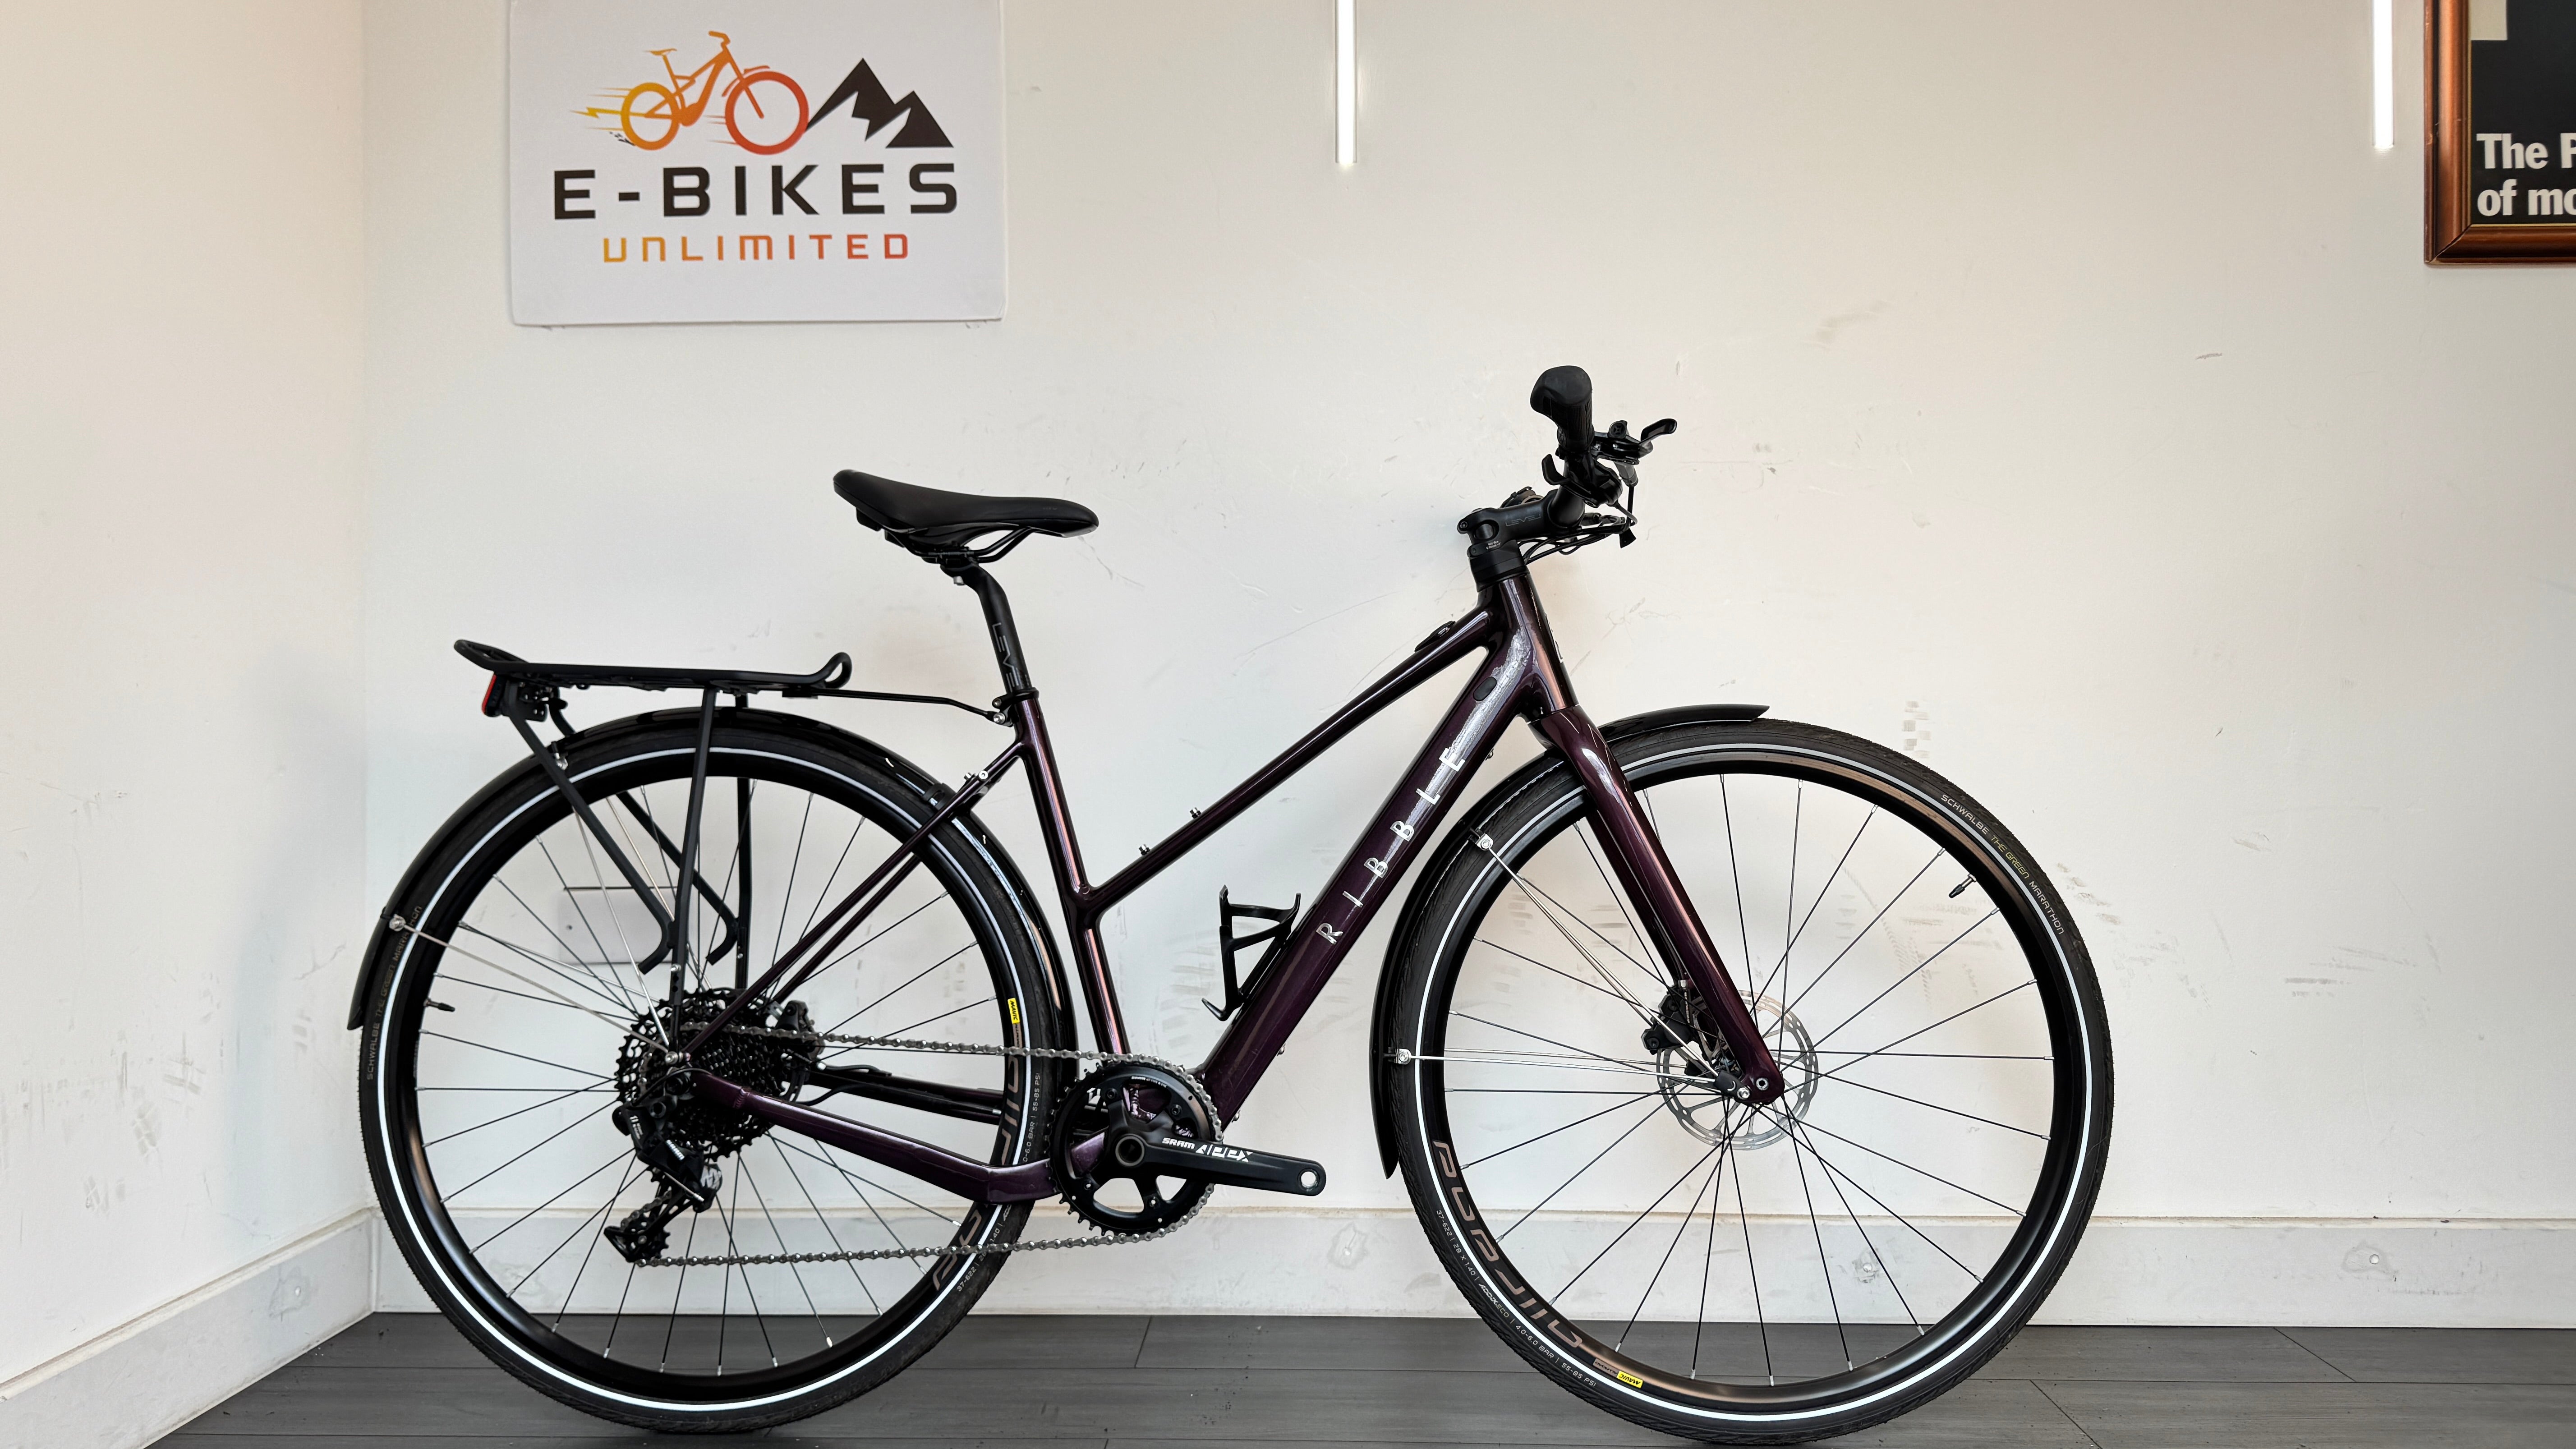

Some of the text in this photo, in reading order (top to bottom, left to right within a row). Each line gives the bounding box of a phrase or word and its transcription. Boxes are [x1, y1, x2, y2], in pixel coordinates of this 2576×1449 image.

[2476, 133, 2549, 170] The
[553, 162, 957, 220] E-BIKES
[2477, 179, 2517, 216] of
[603, 233, 908, 263] UNLIMITED
[992, 622, 1019, 693] LEVE
[1316, 748, 1466, 945] RIBBLE
[1941, 794, 2065, 935] SCHWALBE THE GREEN MARATHON
[392, 906, 422, 964] MARAHON
[1009, 1000, 1018, 1021] MAVIC
[1162, 1137, 1195, 1149] SRAM
[1436, 1210, 1453, 1237] 37-622
[1464, 1261, 1476, 1276] 1.40
[1538, 1345, 1555, 1359] BAR
[1583, 1377, 1596, 1387] PSI
[1619, 1373, 1642, 1385] MAVIC
